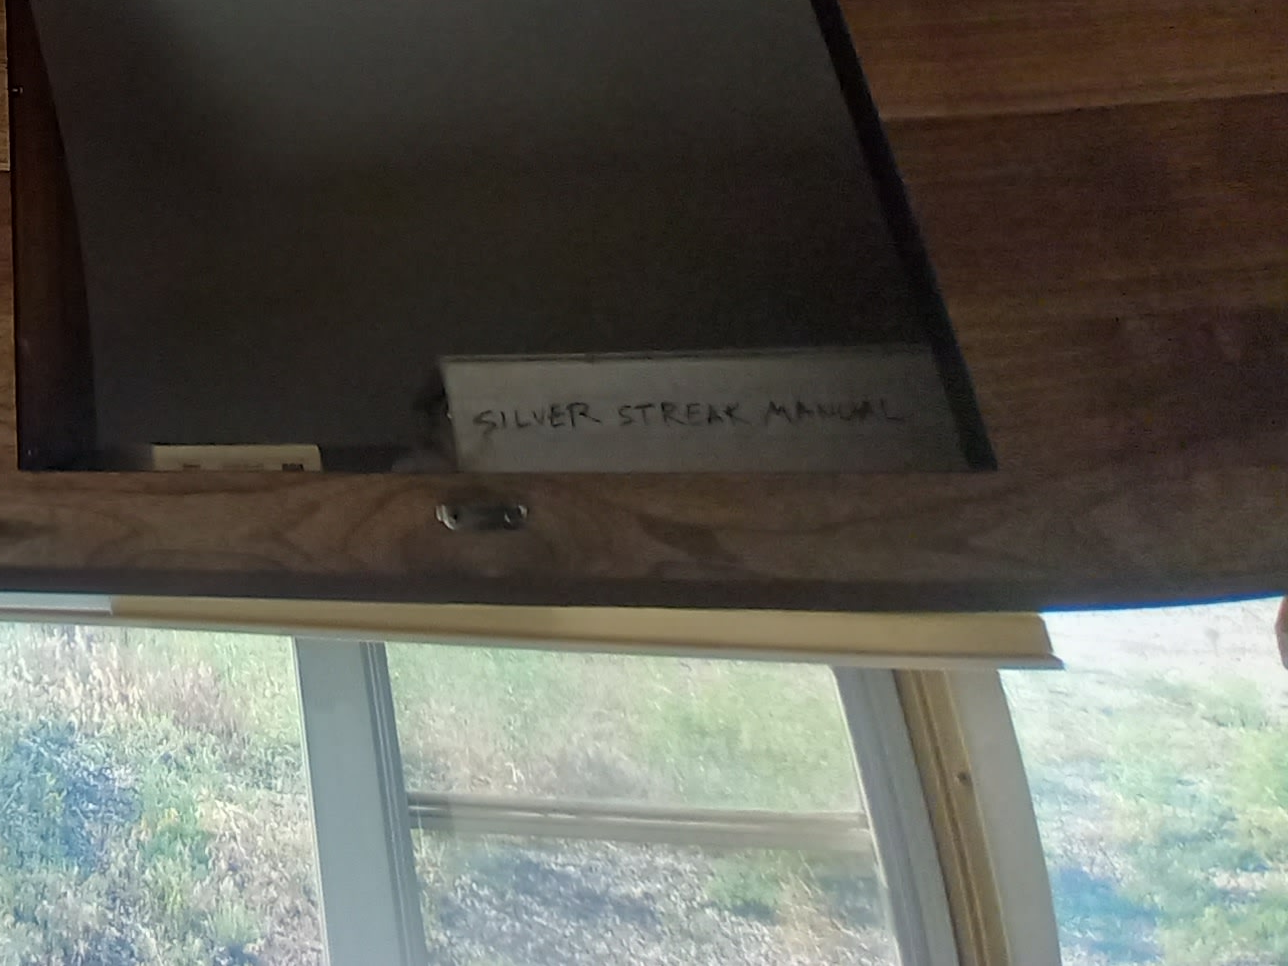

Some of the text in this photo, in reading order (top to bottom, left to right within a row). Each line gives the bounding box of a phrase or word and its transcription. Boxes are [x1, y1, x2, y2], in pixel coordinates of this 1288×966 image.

[472, 398, 906, 436] SILVER STREAK MANUAL
